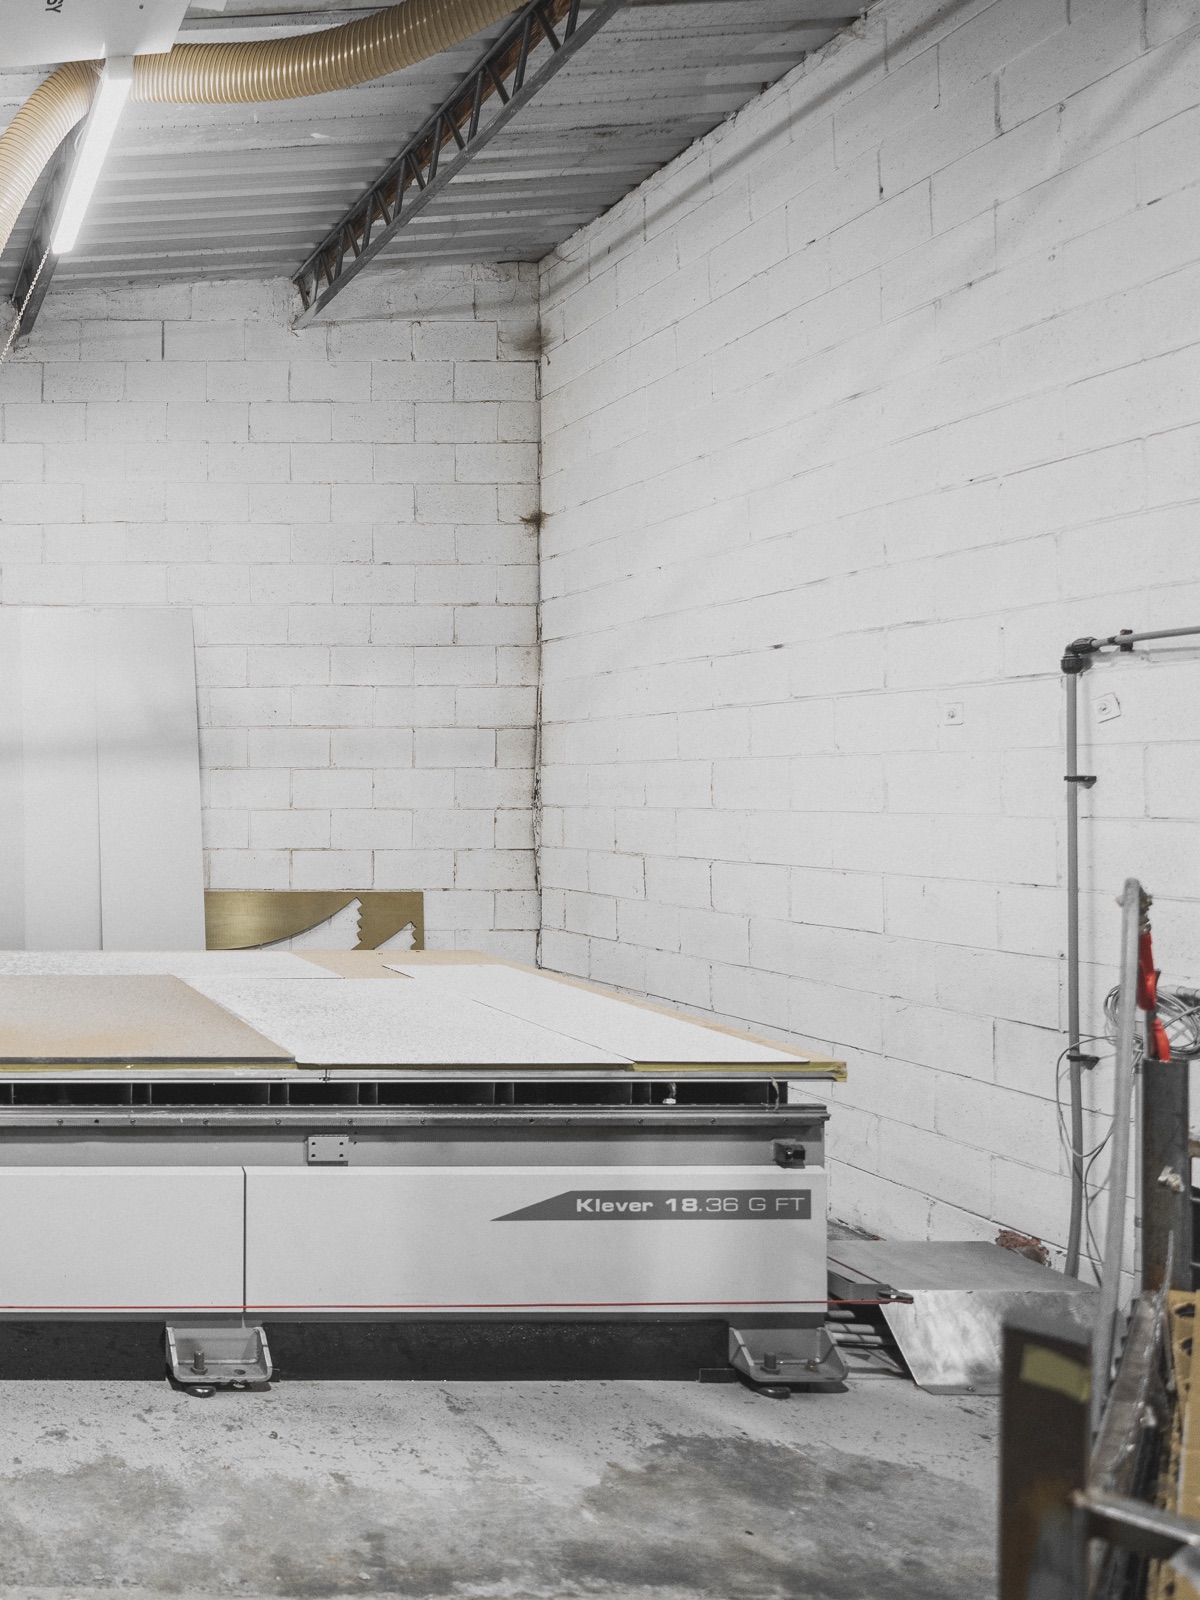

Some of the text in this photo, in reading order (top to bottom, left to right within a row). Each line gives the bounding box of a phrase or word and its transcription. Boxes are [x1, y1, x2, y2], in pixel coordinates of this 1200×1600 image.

[576, 1197, 805, 1212] Klever 18.36 G FT
